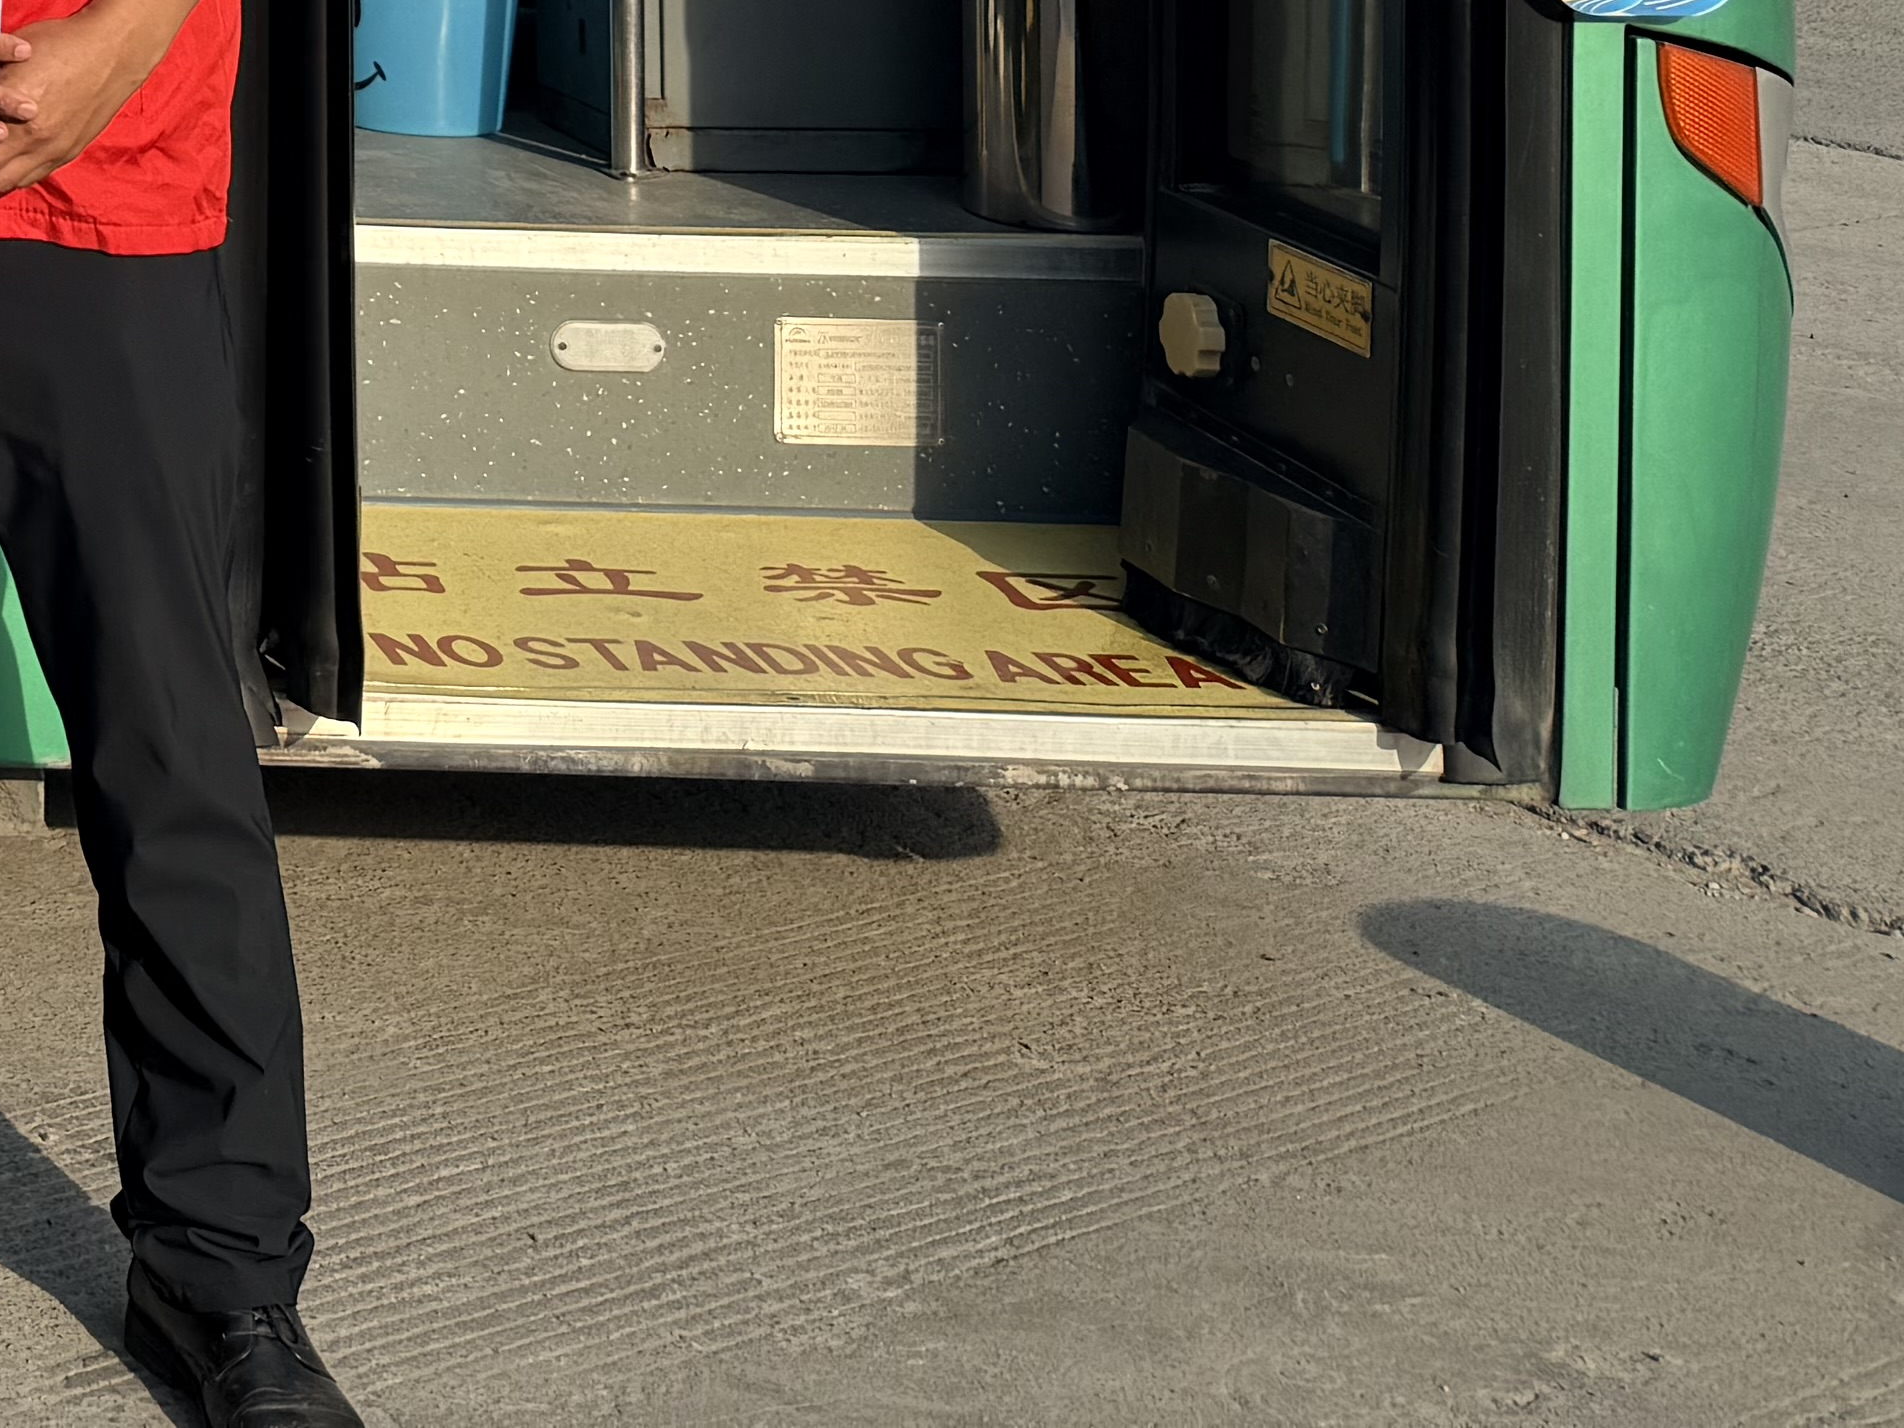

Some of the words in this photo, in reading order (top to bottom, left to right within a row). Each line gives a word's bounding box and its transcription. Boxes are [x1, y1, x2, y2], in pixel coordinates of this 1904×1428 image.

[369, 632, 504, 670] NO
[514, 636, 972, 681] STANDING
[985, 648, 1248, 691] AREA
